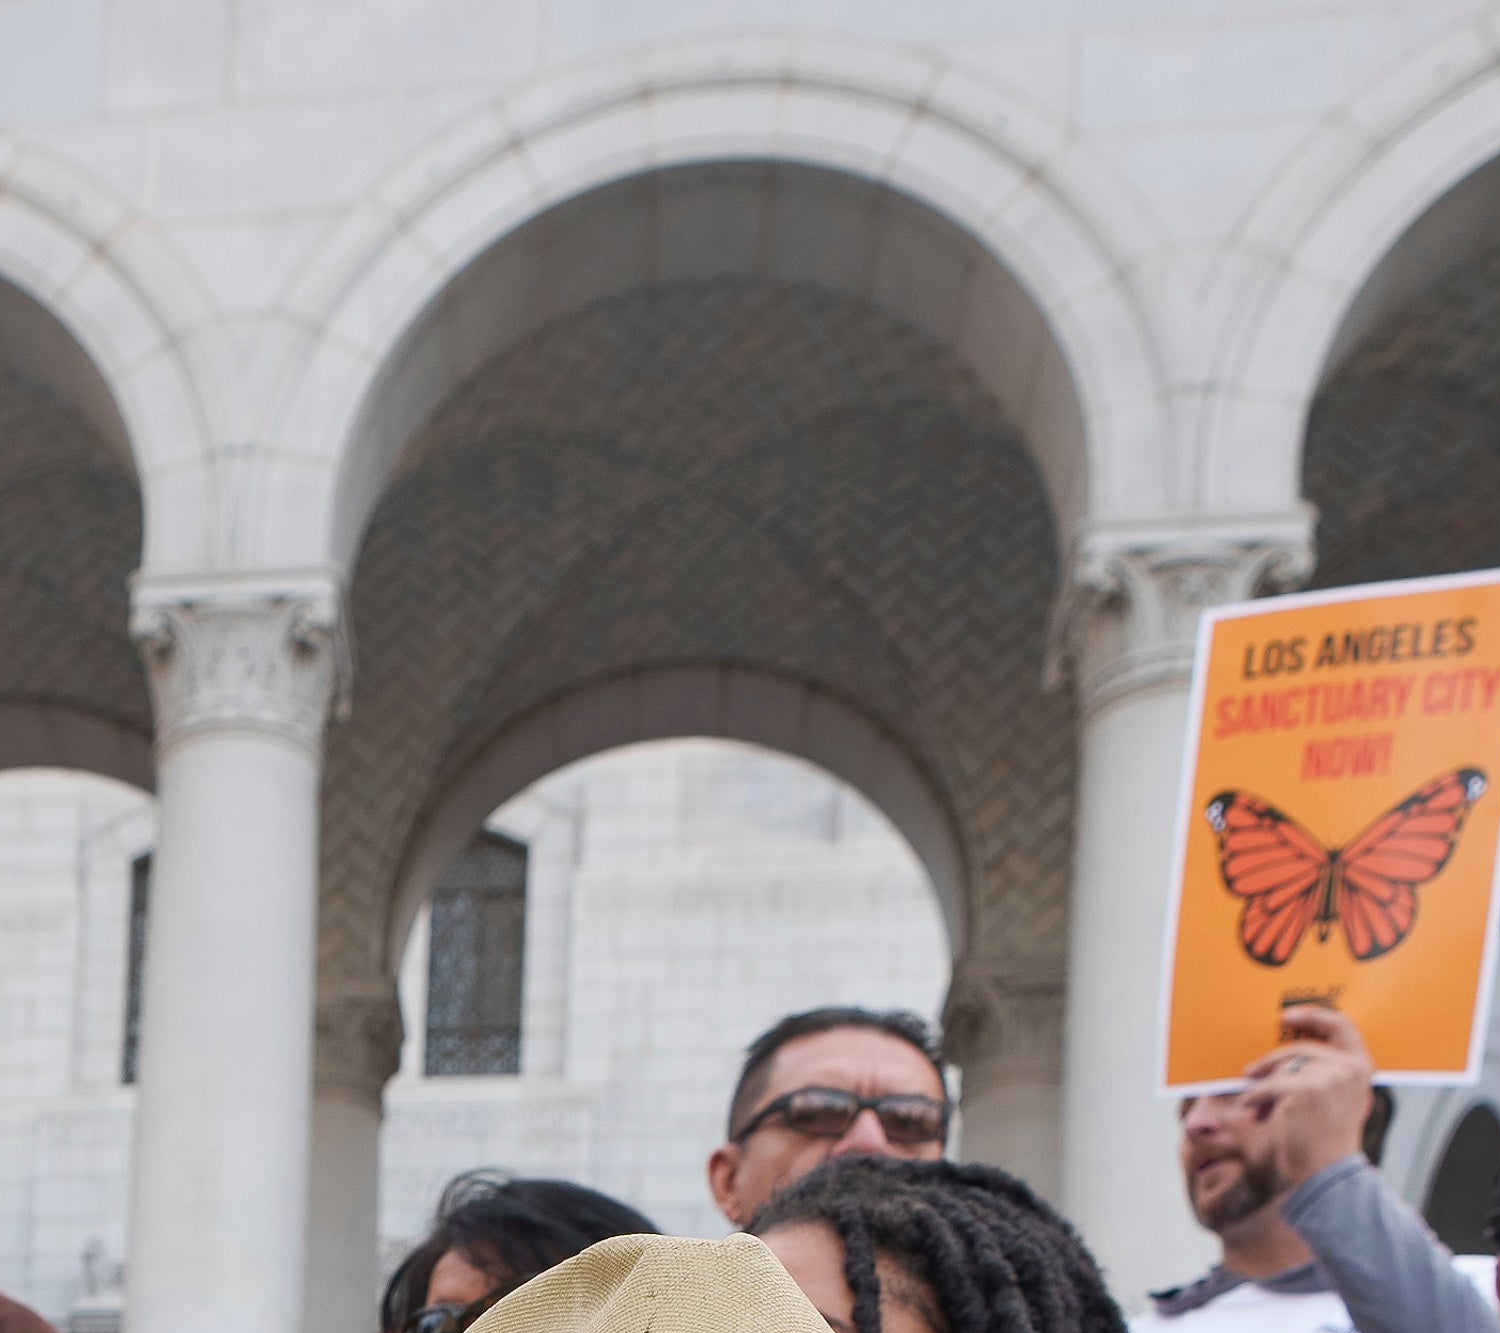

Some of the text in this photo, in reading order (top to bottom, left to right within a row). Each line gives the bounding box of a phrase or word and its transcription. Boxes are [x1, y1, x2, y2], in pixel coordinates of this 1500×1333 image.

[1243, 617, 1478, 681] LOS ANGELES
[1213, 672, 1419, 739] SANCTUARY
